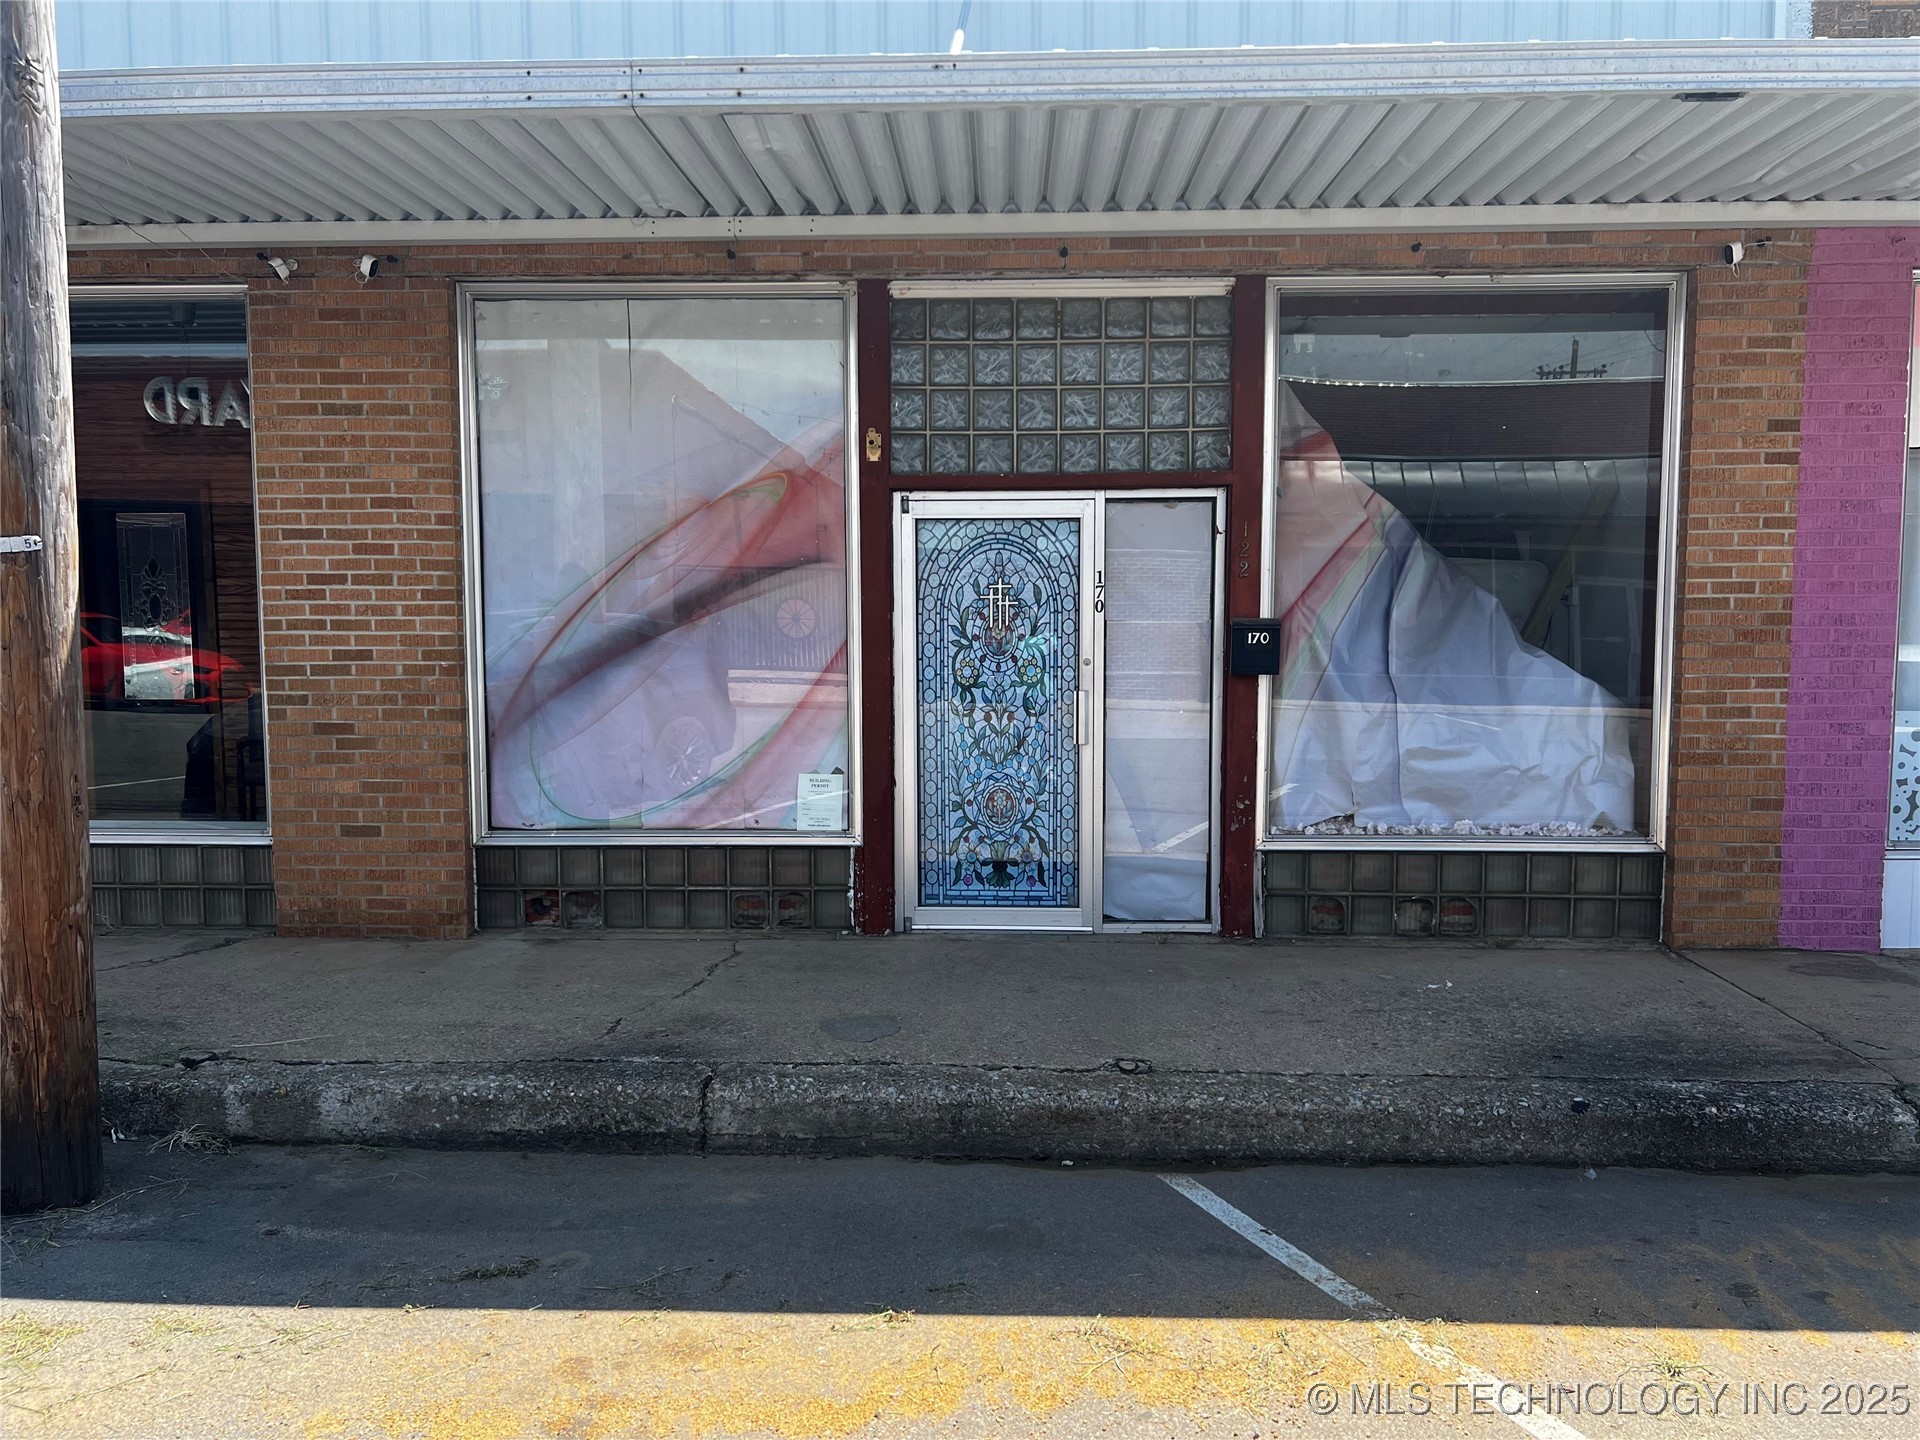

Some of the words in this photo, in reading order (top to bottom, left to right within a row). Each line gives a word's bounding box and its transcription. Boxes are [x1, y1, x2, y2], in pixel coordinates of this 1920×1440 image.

[24, 538, 31, 549] 5
[1240, 521, 1250, 578] 122
[1095, 570, 1105, 613] 170
[1247, 632, 1270, 645] 170
